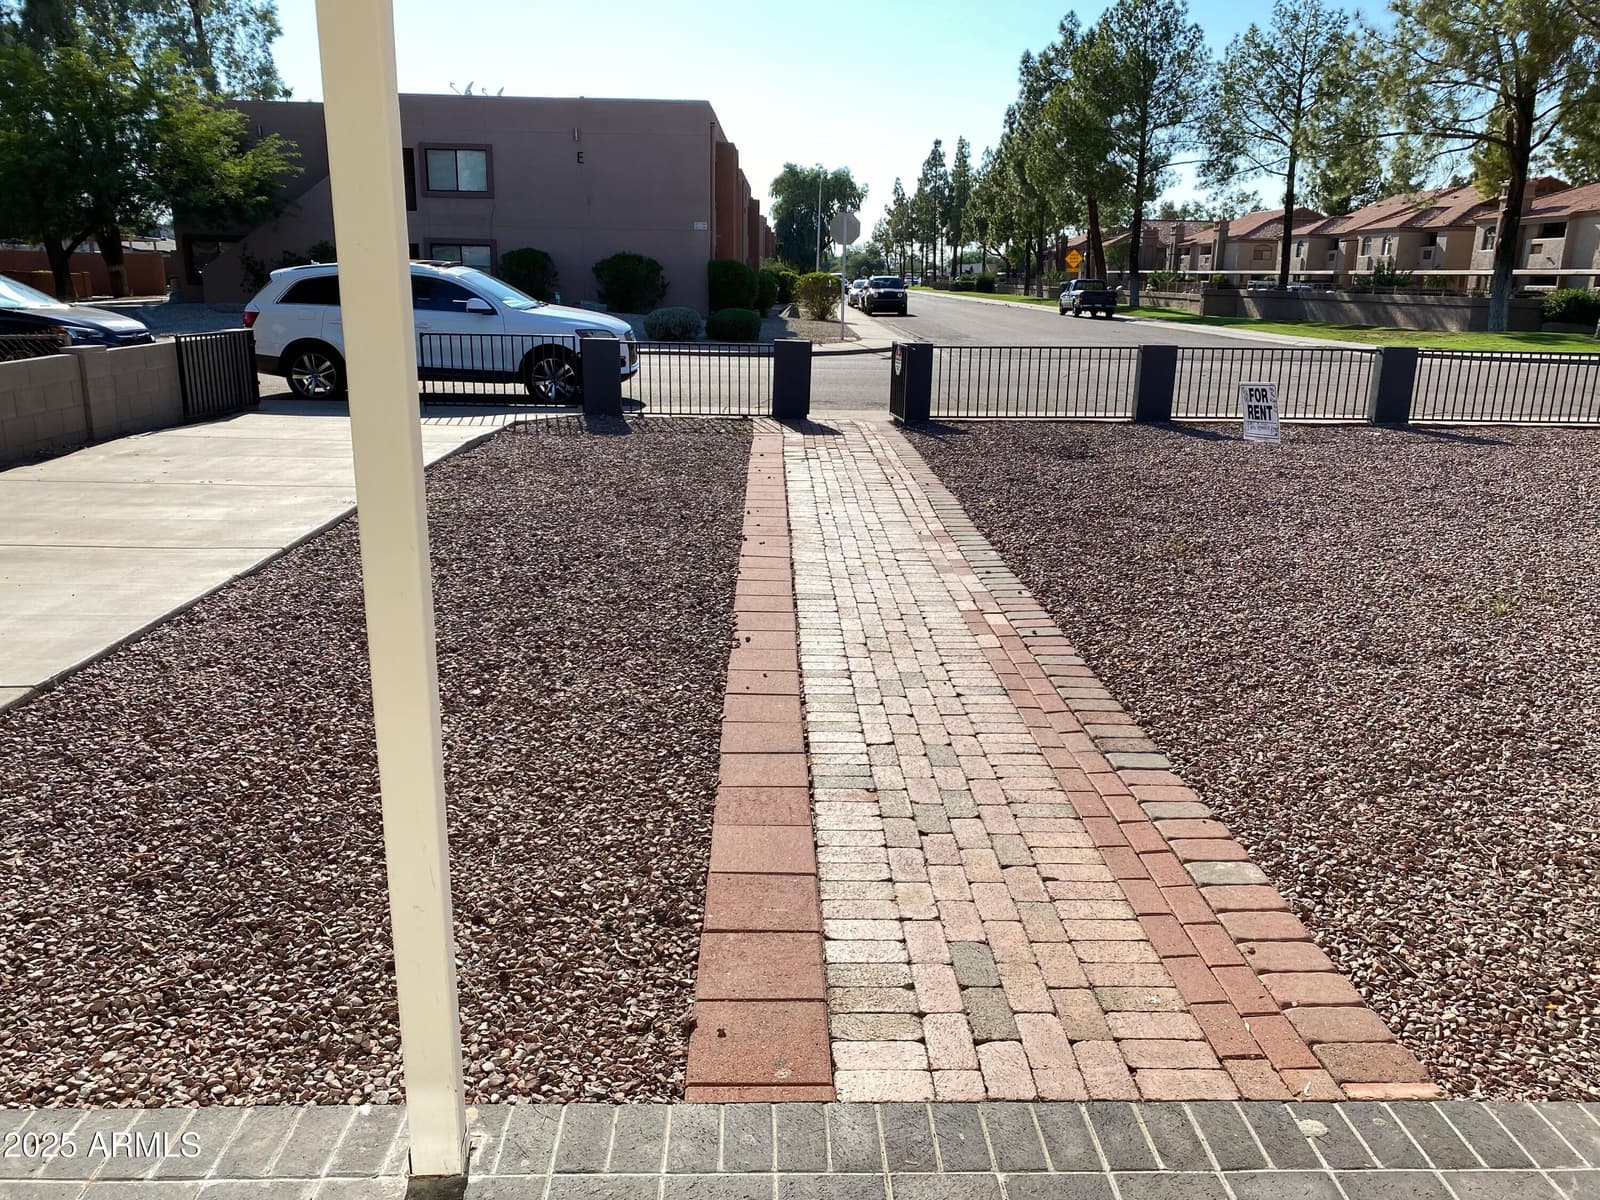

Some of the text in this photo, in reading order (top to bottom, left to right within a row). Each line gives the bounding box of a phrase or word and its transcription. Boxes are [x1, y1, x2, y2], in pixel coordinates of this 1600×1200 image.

[577, 151, 584, 164] E
[1248, 387, 1269, 403] FOR
[1247, 404, 1273, 421] RENT
